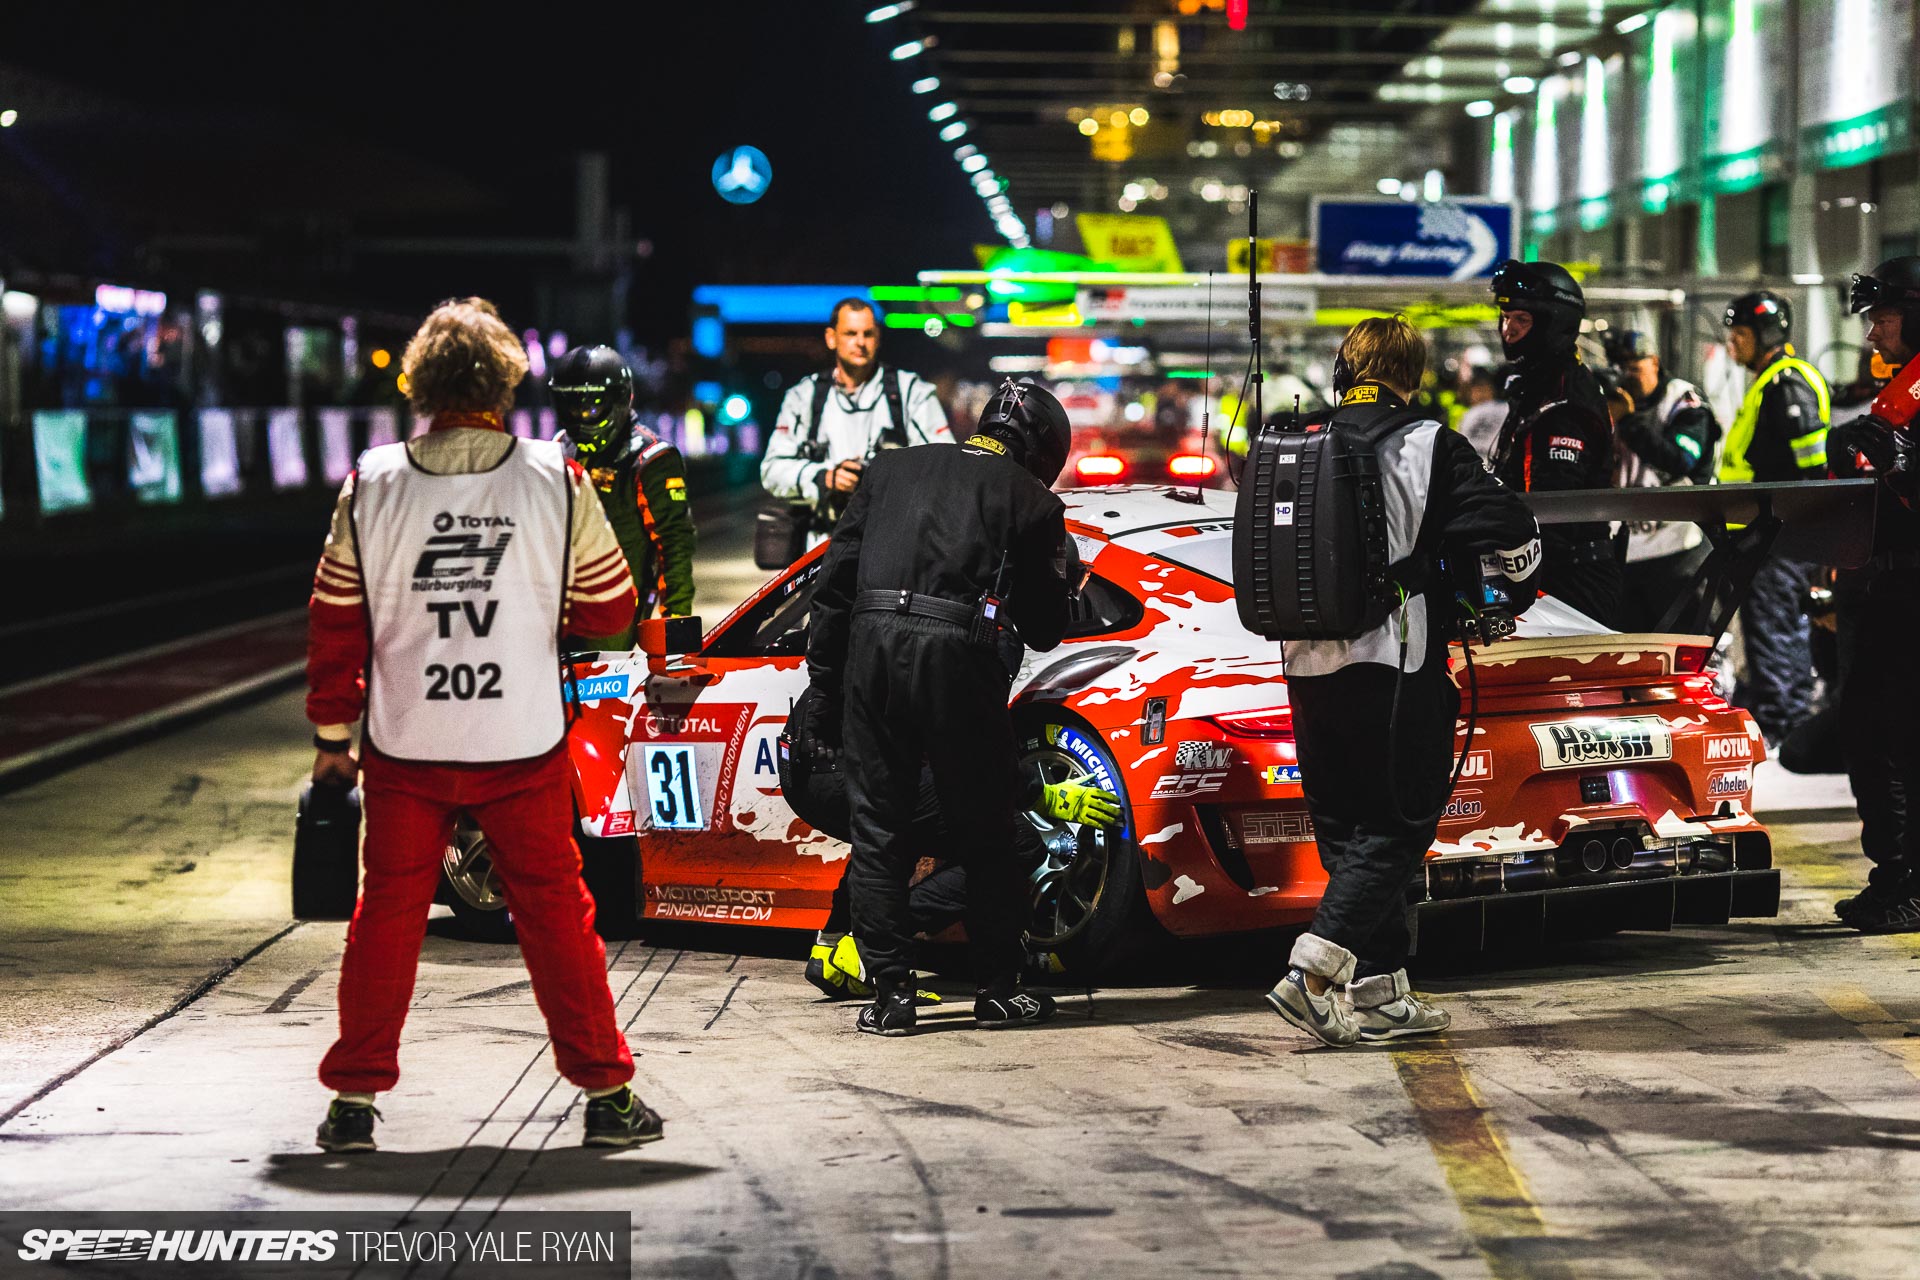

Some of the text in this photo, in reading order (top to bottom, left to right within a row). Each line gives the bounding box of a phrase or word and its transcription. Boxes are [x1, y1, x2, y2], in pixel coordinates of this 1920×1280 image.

[1551, 436, 1583, 450] MOTUL
[457, 515, 516, 529] TOTAL
[1497, 540, 1541, 573] EDIA
[411, 576, 493, 593] nürburgring
[426, 600, 499, 639] TV
[424, 662, 503, 701] 202
[587, 680, 622, 696] JAKO
[667, 714, 722, 734] TOTAL
[1707, 738, 1751, 759] MOTUL
[714, 705, 751, 830] ADAC NORDRHEIN
[1184, 749, 1233, 770] KW
[650, 750, 697, 824] 31
[1153, 772, 1228, 790] PFC
[1708, 775, 1748, 794] Abbelen
[655, 886, 776, 904] MOTORSPORT
[655, 903, 773, 921] FINANCE.COM
